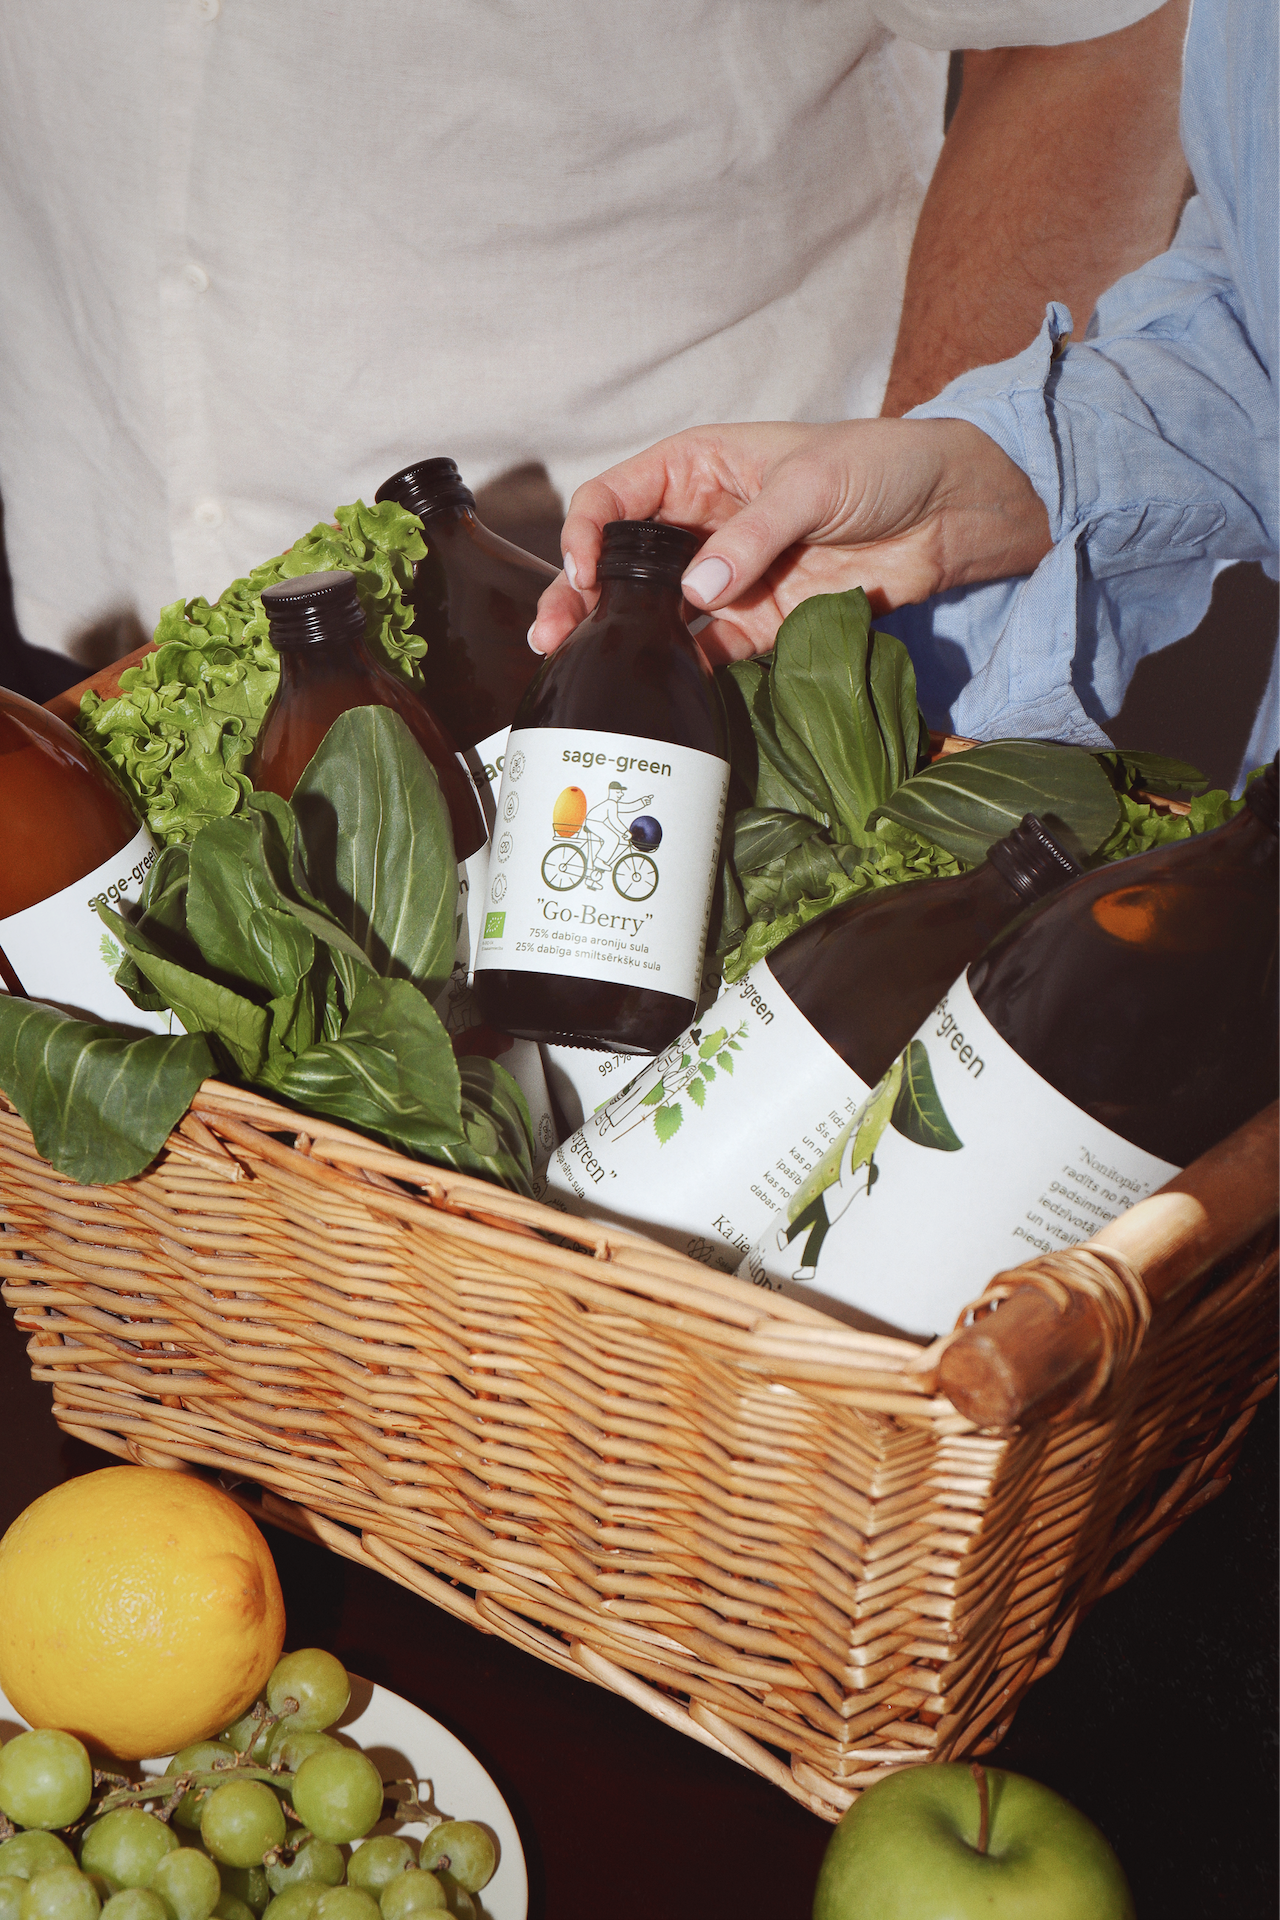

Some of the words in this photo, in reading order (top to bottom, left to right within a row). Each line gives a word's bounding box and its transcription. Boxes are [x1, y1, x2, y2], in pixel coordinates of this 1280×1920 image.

[562, 750, 672, 776] sage-green
[529, 928, 549, 939] 75%
[551, 930, 587, 945] dabīga
[590, 937, 627, 951] aroniju
[630, 944, 649, 954] sula
[515, 942, 534, 952] 25%
[537, 944, 571, 958] dabīga
[643, 958, 661, 971] sula
[598, 1053, 631, 1077] 99.7%
[802, 1135, 815, 1148] un
[815, 1121, 830, 1139] Šis
[788, 1146, 806, 1164] kas
[762, 1170, 780, 1188] kas
[750, 1184, 777, 1210] dabas
[711, 1214, 735, 1239] Kā
